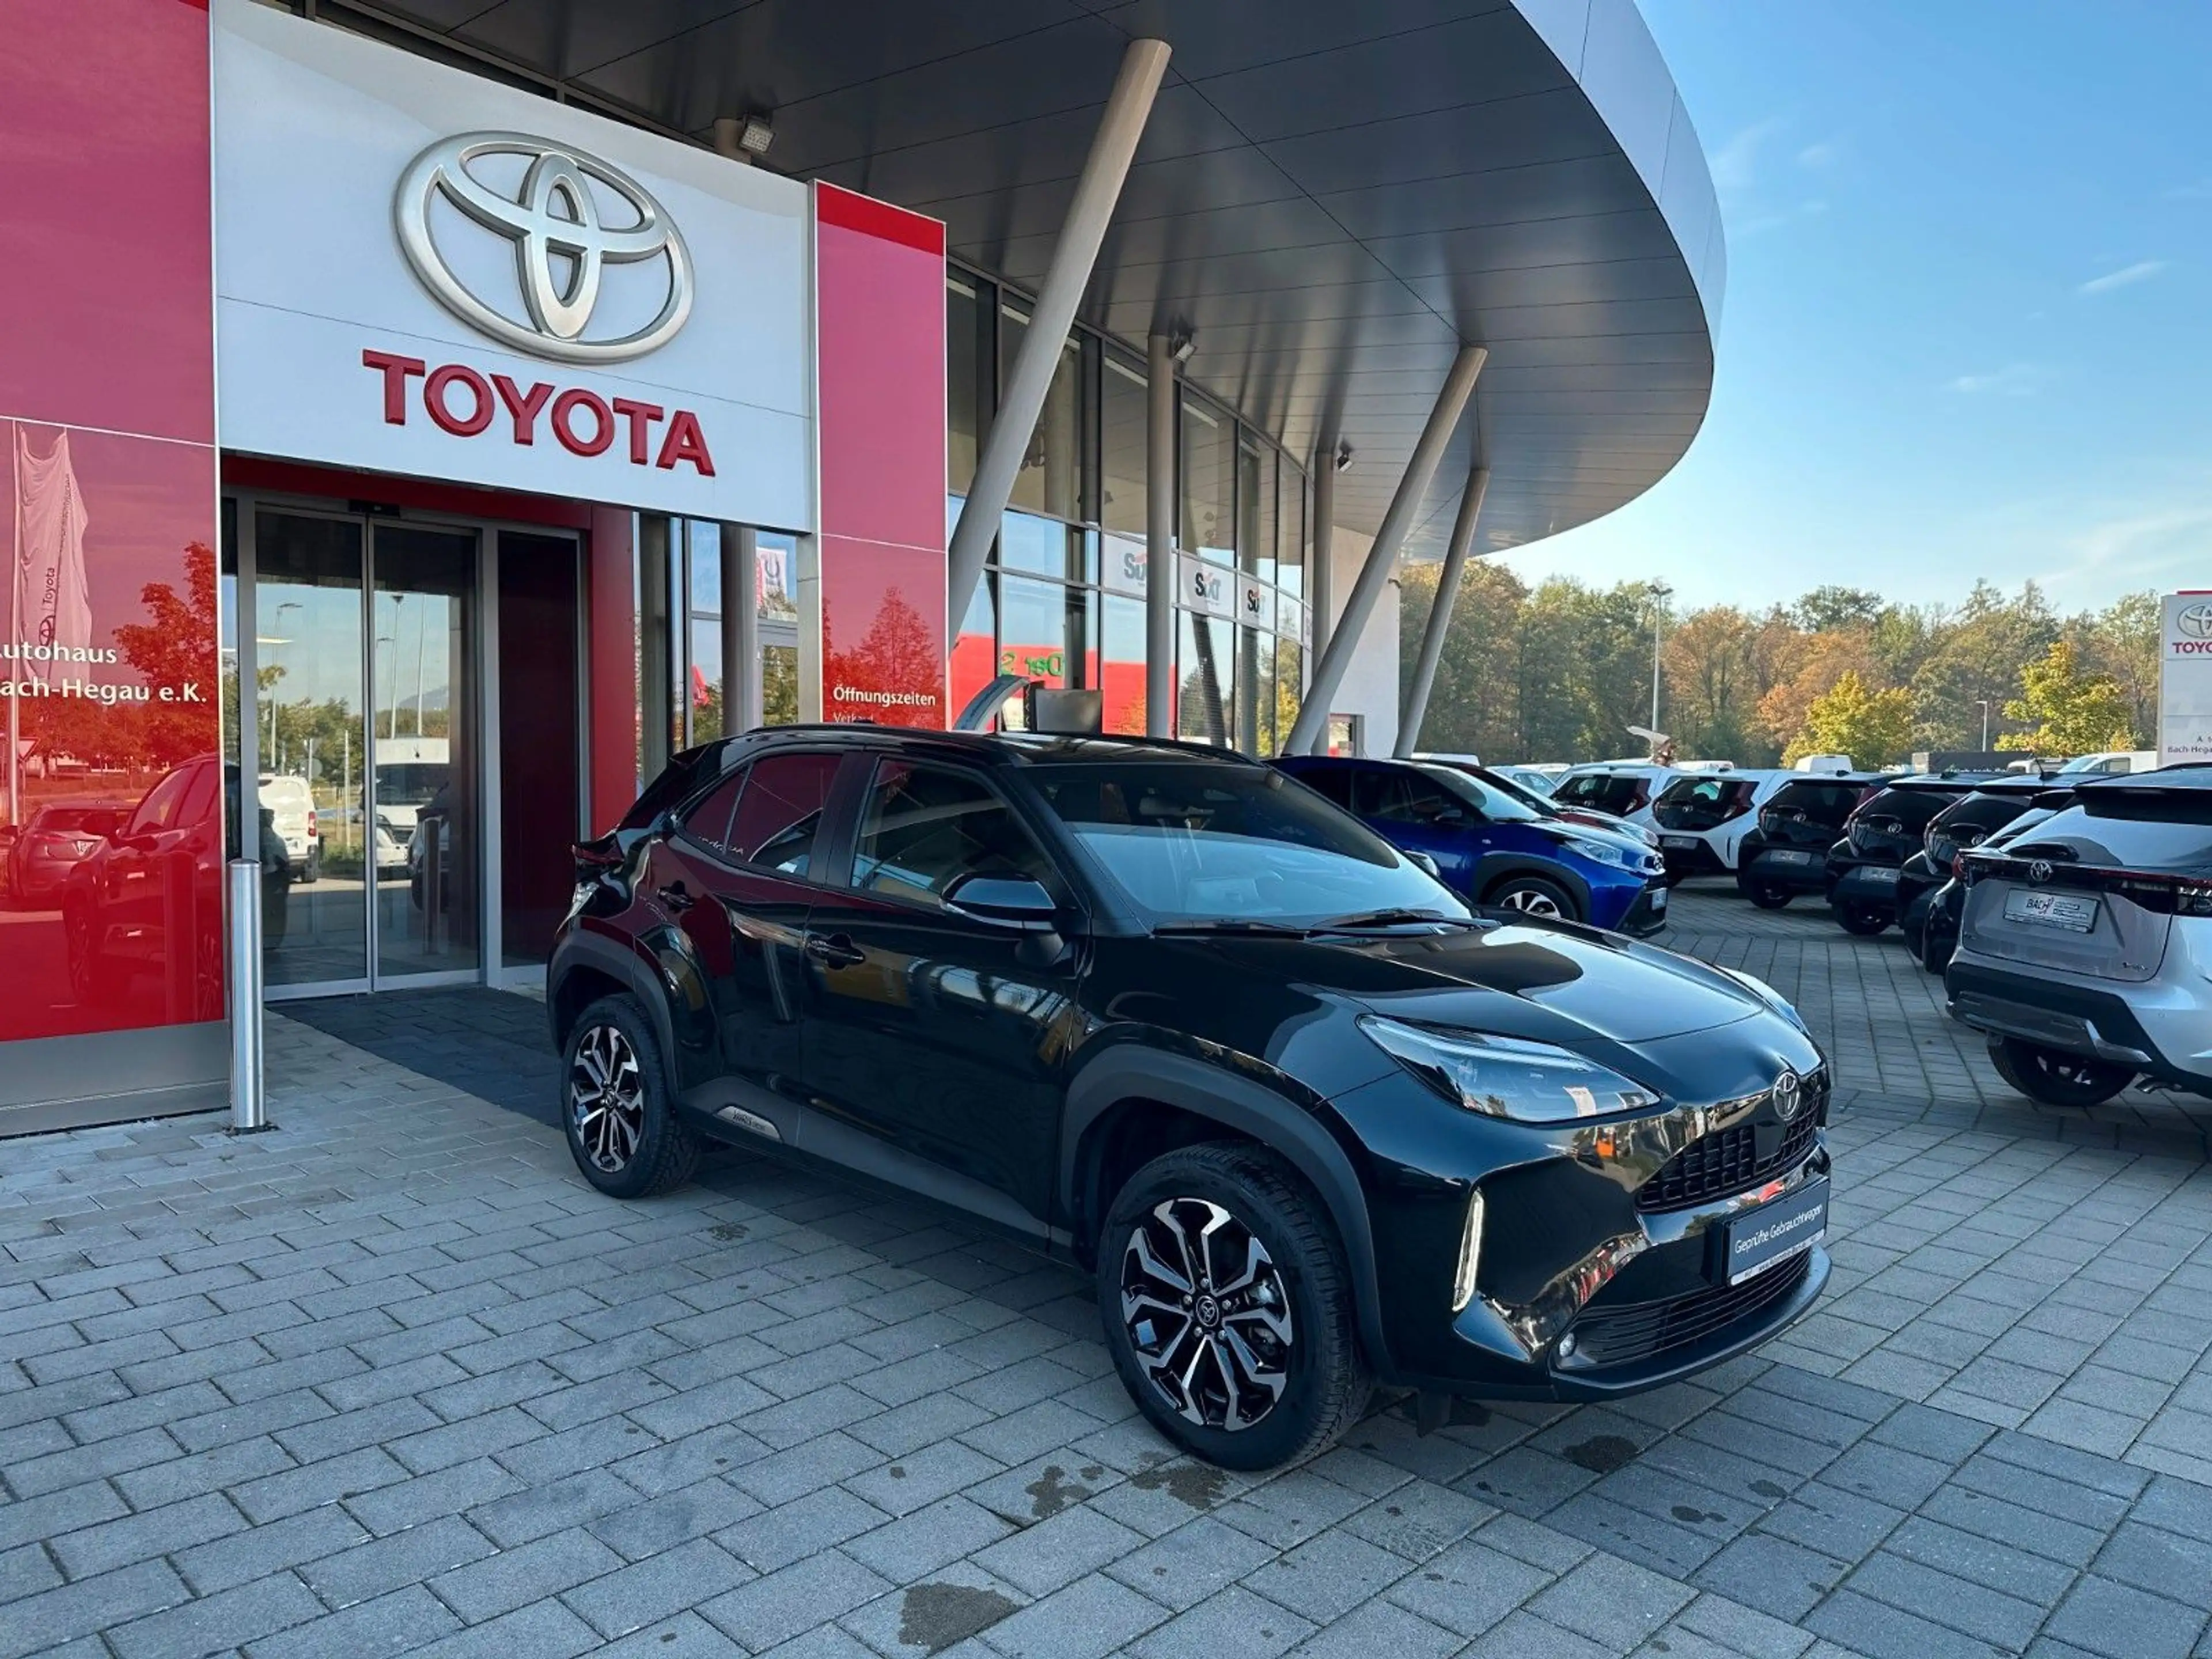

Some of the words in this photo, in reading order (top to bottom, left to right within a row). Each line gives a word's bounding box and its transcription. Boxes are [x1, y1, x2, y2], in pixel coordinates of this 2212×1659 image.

[363, 349, 716, 477] TOYOTA
[43, 567, 55, 605] Toyota
[0, 640, 117, 663] utohaus
[2172, 642, 2212, 653] TOYO
[0, 676, 150, 706] ach-Hegau
[159, 683, 207, 703] e.K.
[833, 683, 935, 707] Öffnungszeiten
[1735, 1229, 1770, 1253] Geprüfte
[1770, 1203, 1824, 1238] Gebrauchtwagen
